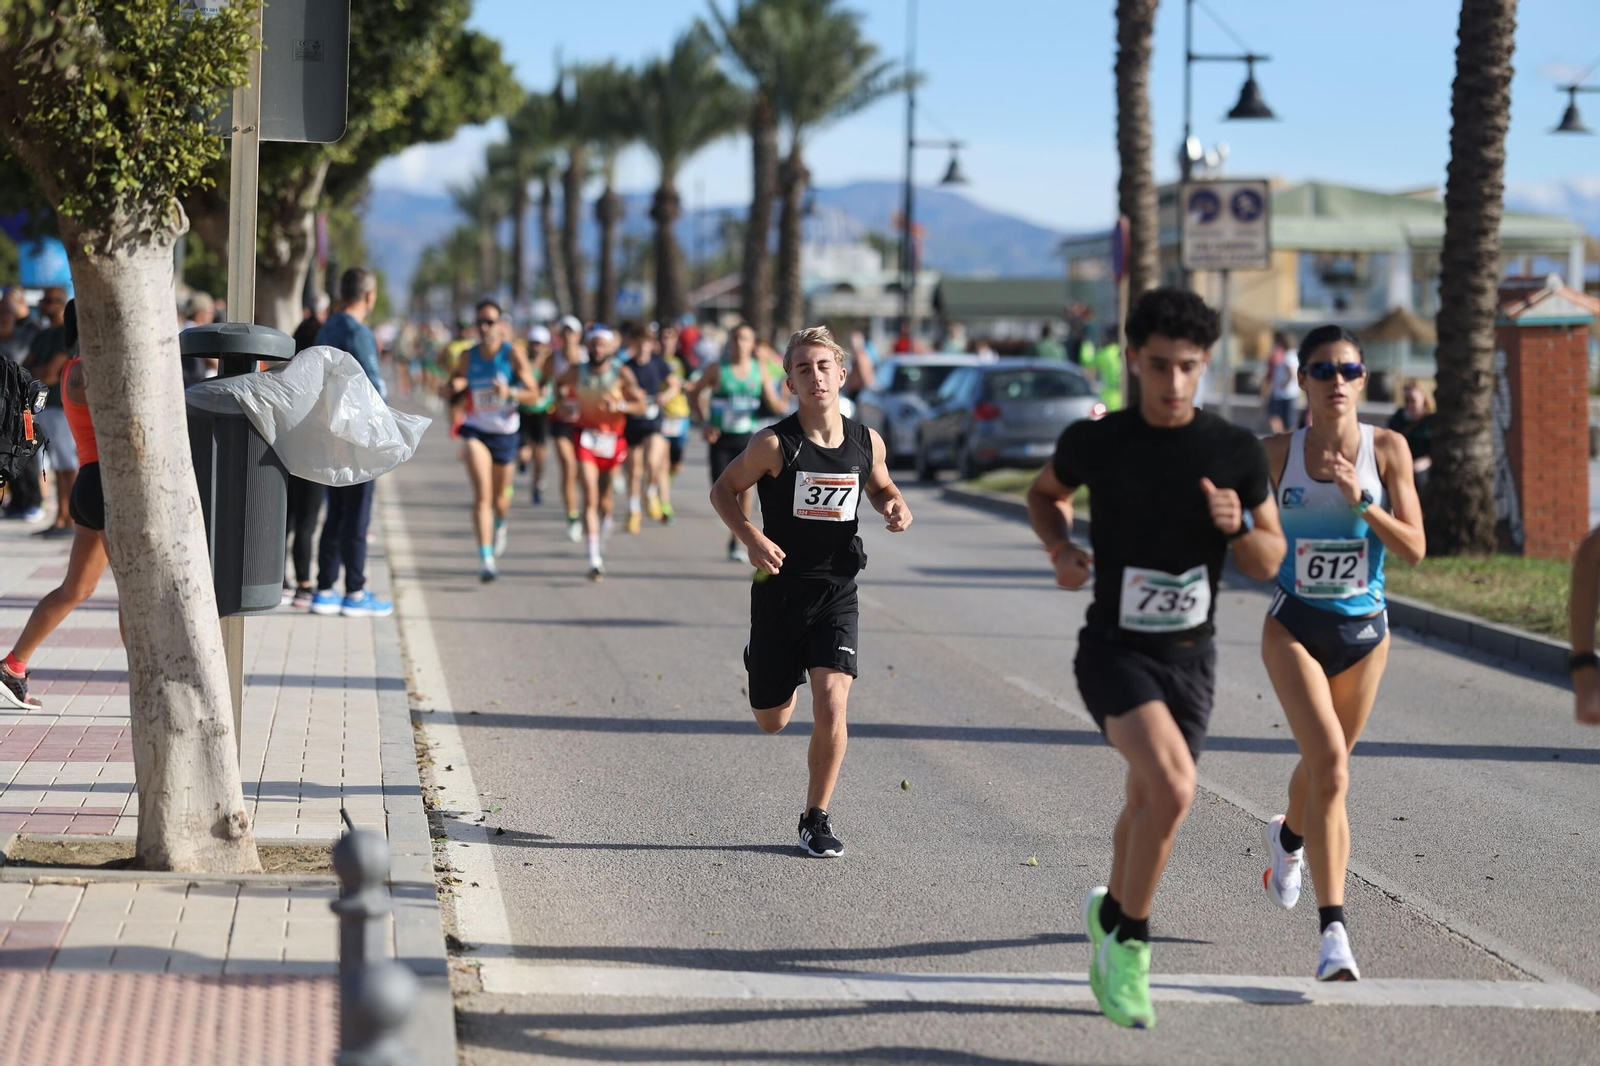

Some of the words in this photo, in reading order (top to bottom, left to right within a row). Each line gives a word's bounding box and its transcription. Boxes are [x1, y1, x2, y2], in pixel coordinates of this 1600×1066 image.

[804, 486, 853, 507] 377
[1307, 554, 1358, 580] 612
[1137, 586, 1198, 613] 735
